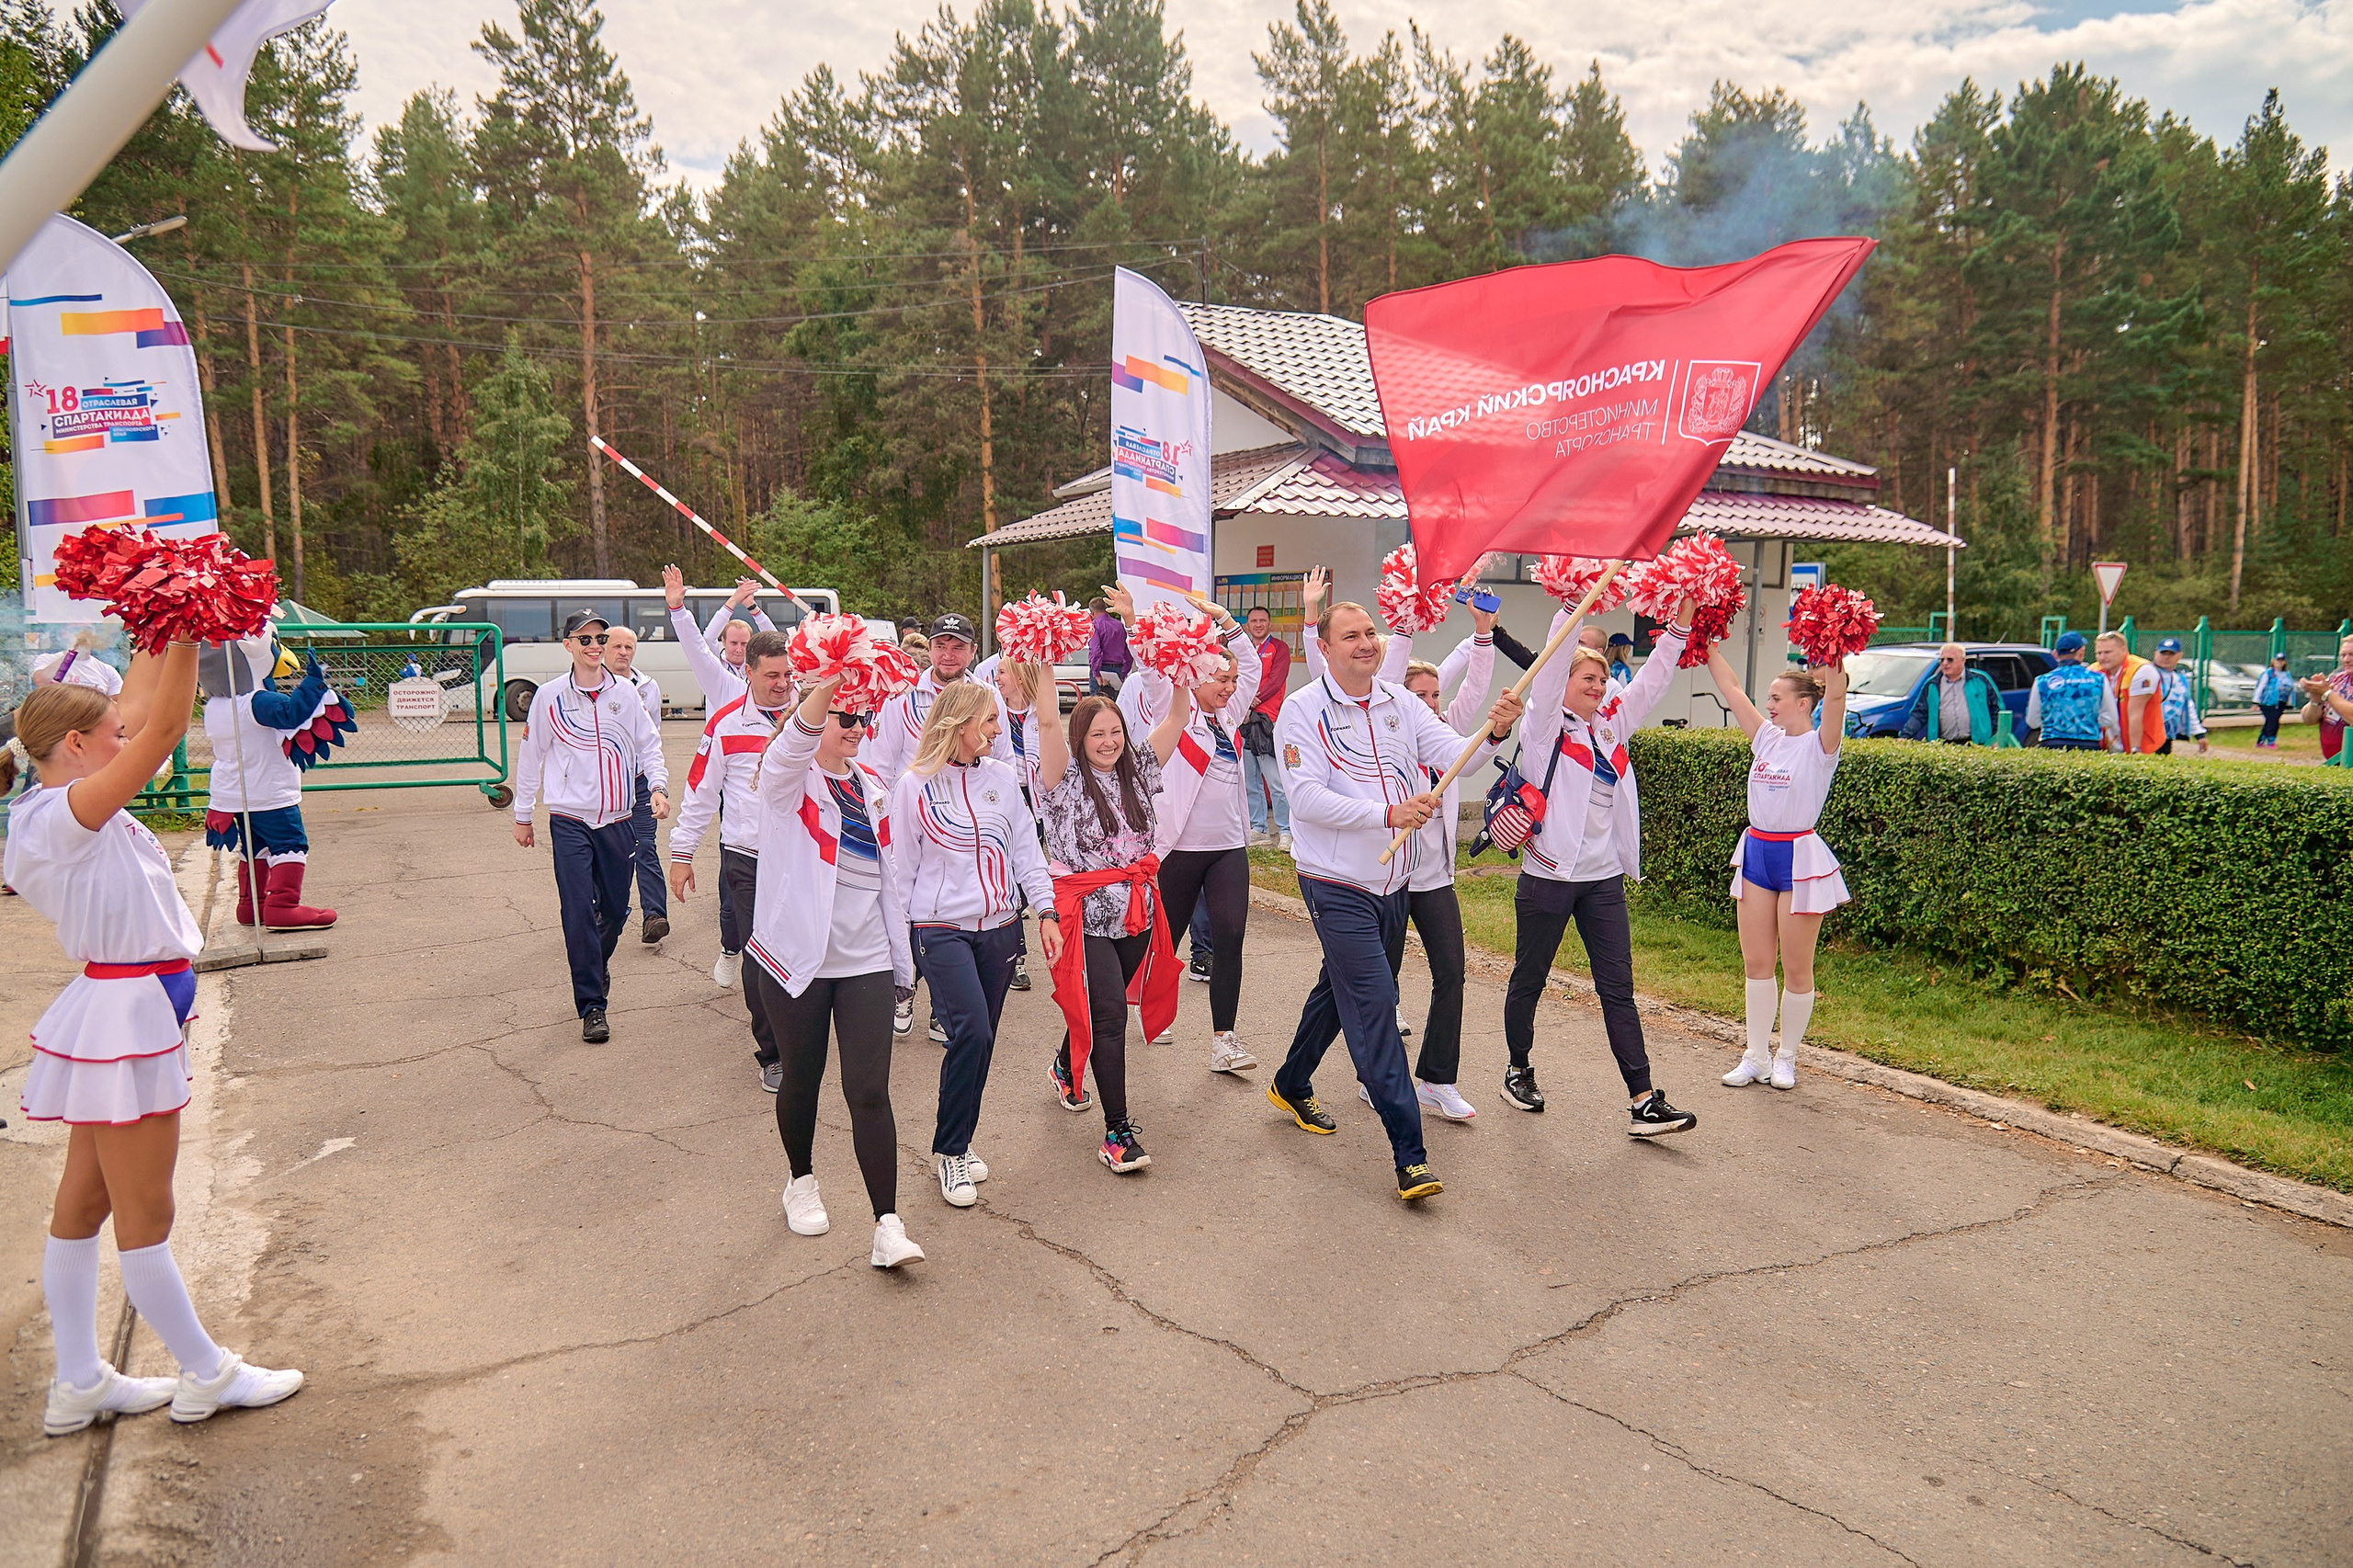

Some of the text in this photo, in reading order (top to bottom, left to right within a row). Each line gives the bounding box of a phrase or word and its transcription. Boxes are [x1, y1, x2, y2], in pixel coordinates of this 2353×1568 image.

[46, 386, 138, 414] 18 ОТРАСЛЕВАЯ
[54, 408, 150, 426] СПАРТАКИАДА
[55, 424, 103, 435] МИНИСТЕРСТВА
[1754, 772, 1790, 781] СПАРТАКИАД
